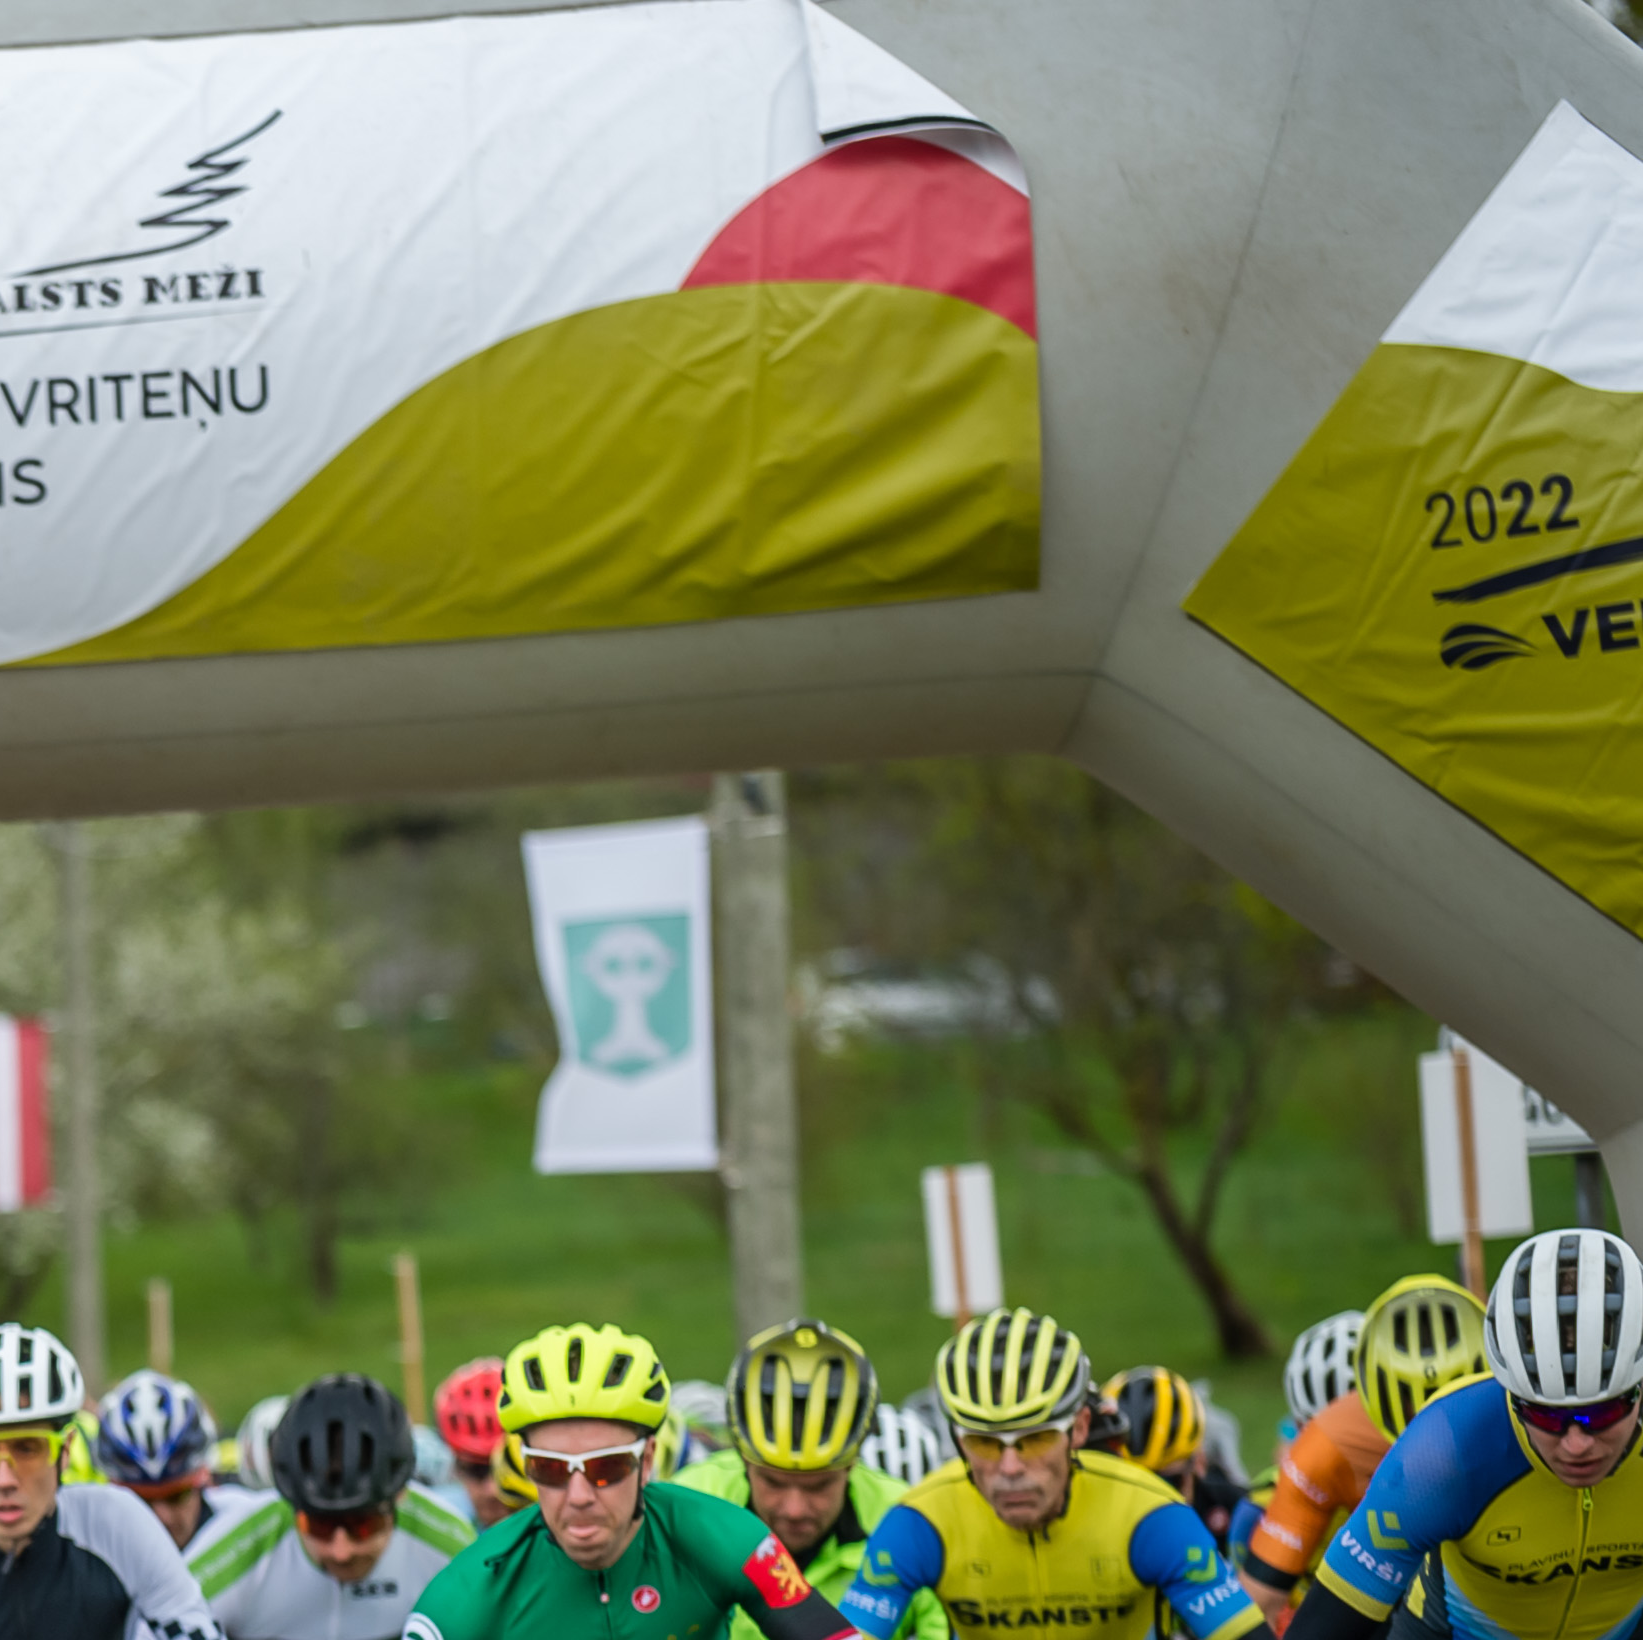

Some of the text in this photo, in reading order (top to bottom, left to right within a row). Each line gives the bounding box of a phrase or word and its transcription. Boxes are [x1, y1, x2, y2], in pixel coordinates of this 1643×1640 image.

[141, 265, 264, 306] MEŽI
[1425, 473, 1579, 550] 2022
[1541, 597, 1643, 659] VE
[1341, 1530, 1403, 1585] VIRŠI
